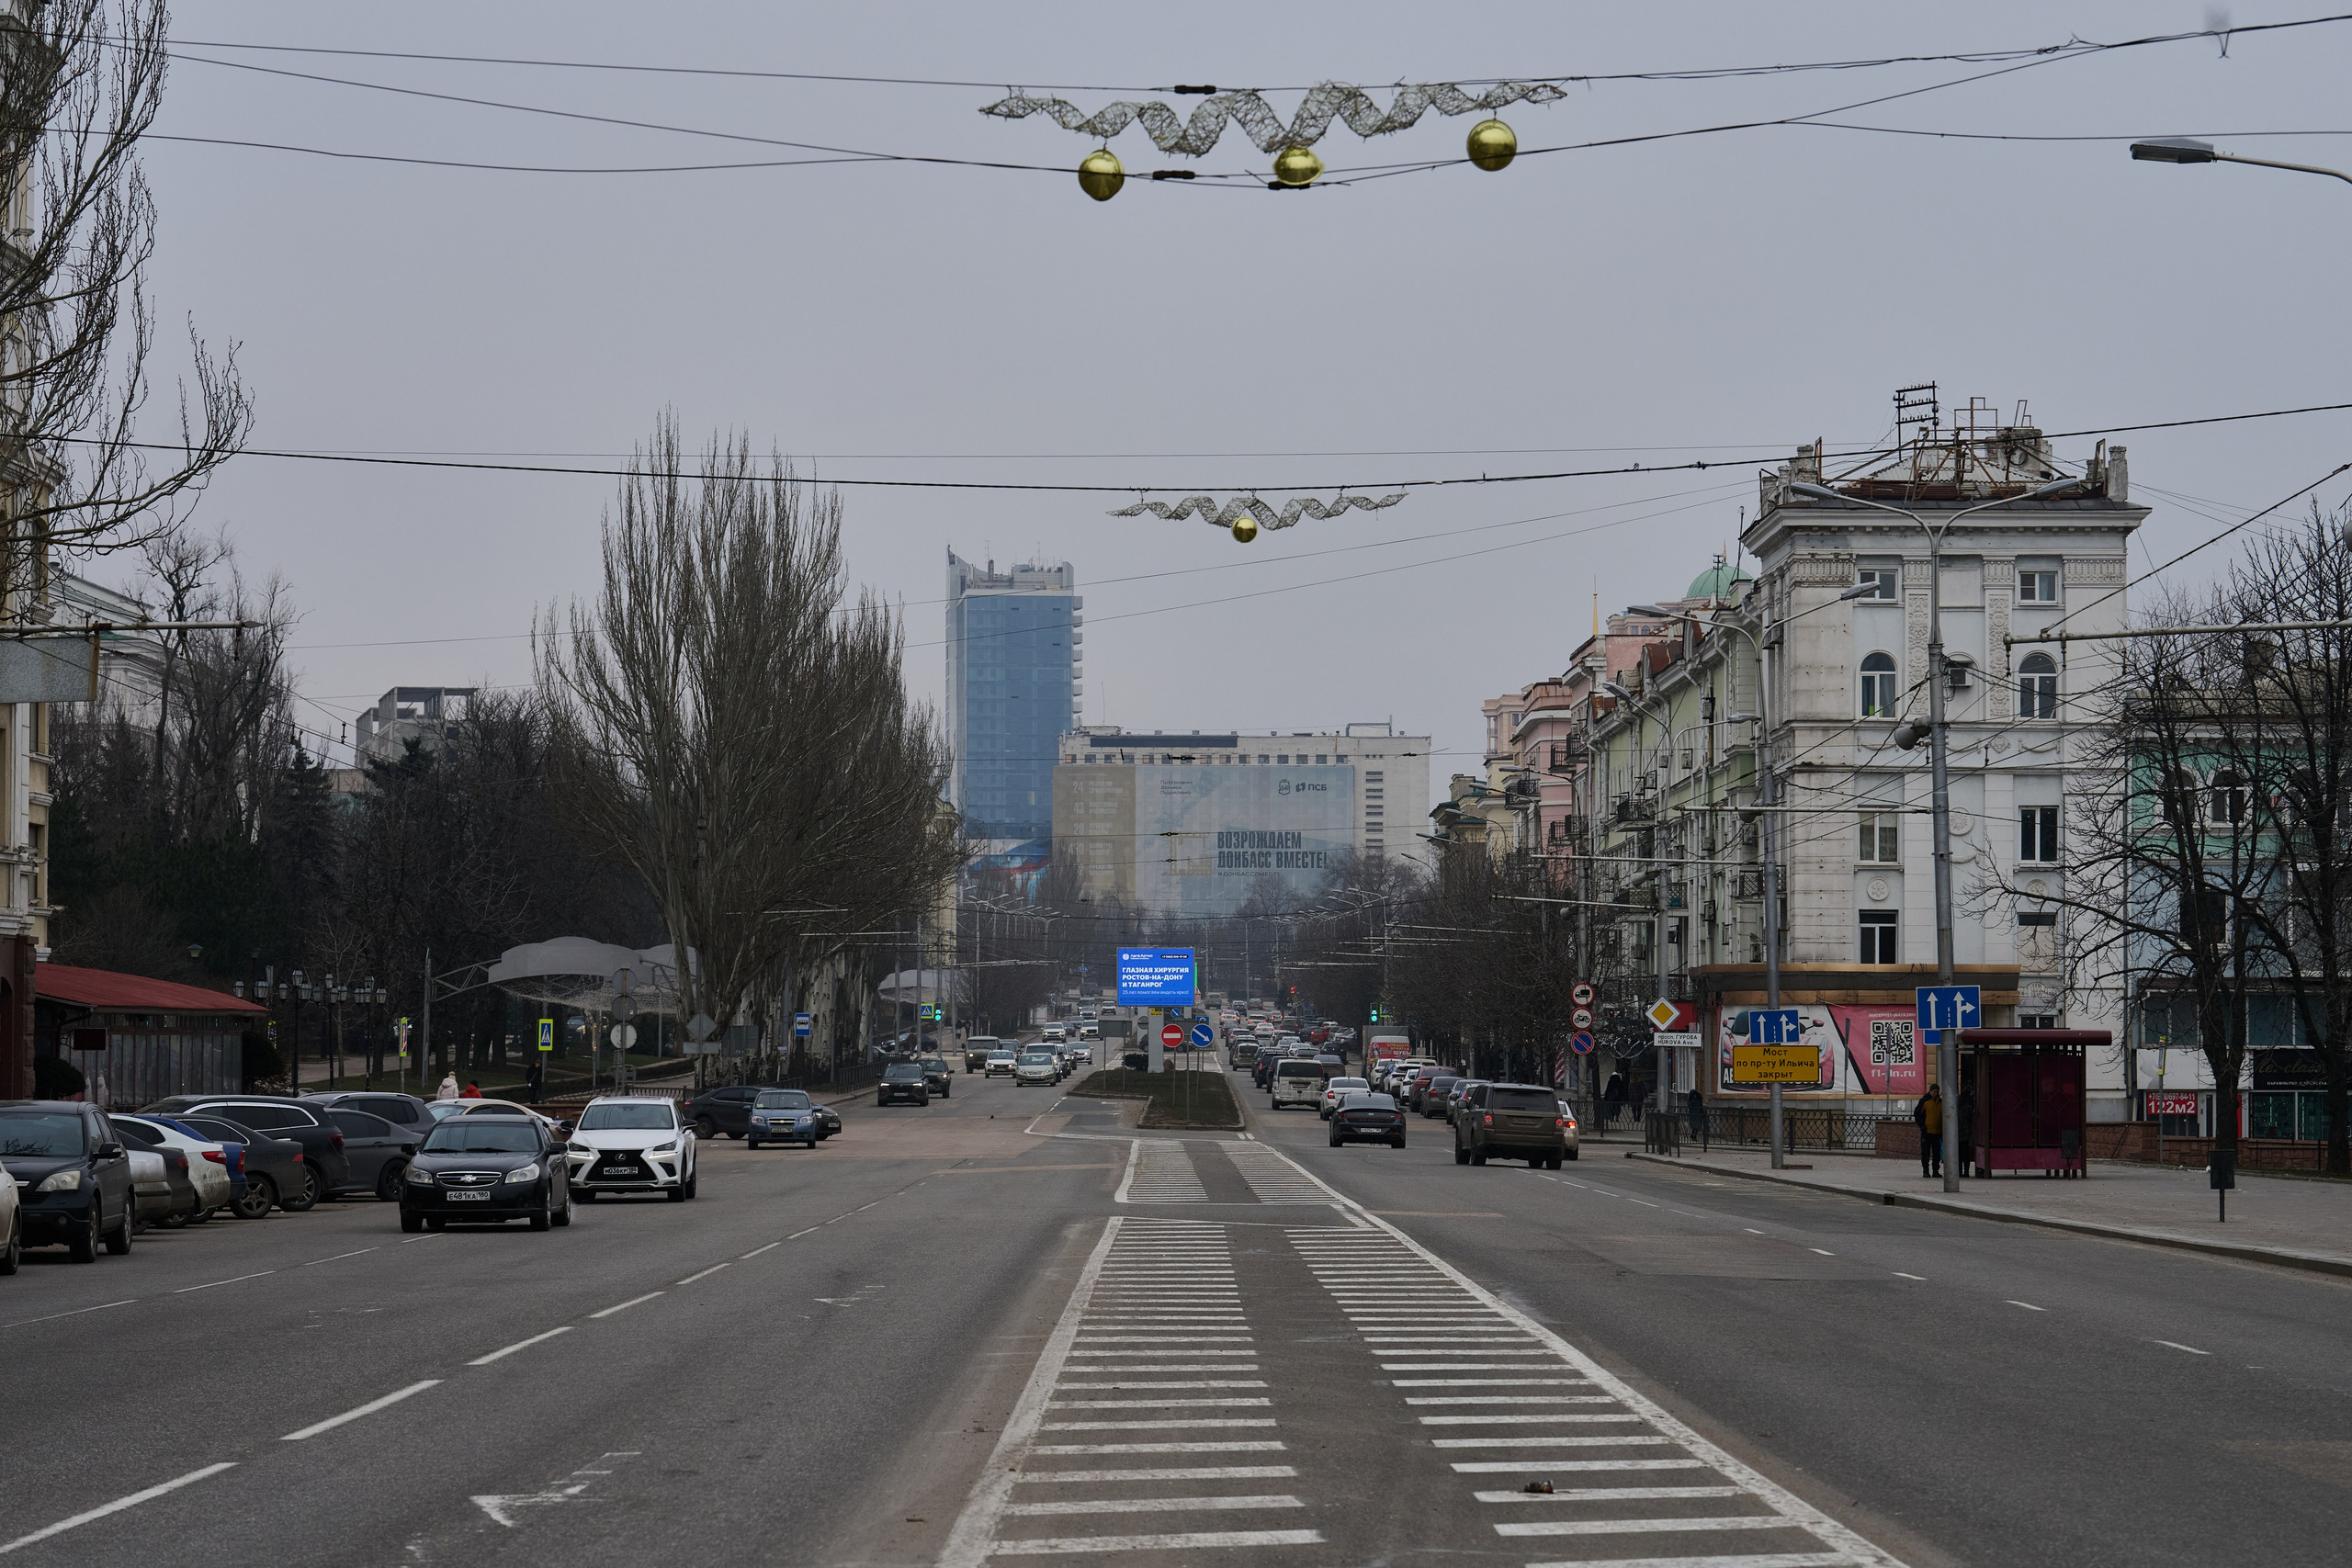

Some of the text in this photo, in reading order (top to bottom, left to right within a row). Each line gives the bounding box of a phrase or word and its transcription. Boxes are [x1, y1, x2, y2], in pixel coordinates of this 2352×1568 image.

[1073, 781, 1084, 794] 24
[1308, 783, 1328, 792] ПСБ
[1073, 802, 1084, 815] 43
[1217, 831, 1301, 850] ВОЗРОЖДАЕМ
[1217, 851, 1328, 869] ДОНБАСС ВМЕСТЕ!
[1763, 1047, 1788, 1055] Мост
[1750, 1060, 1777, 1069] пр-ту
[1779, 1058, 1815, 1067] Ильича
[1758, 1071, 1793, 1080] закрыт
[2149, 1100, 2196, 1113] 122м2
[448, 1191, 476, 1201] Е481КА
